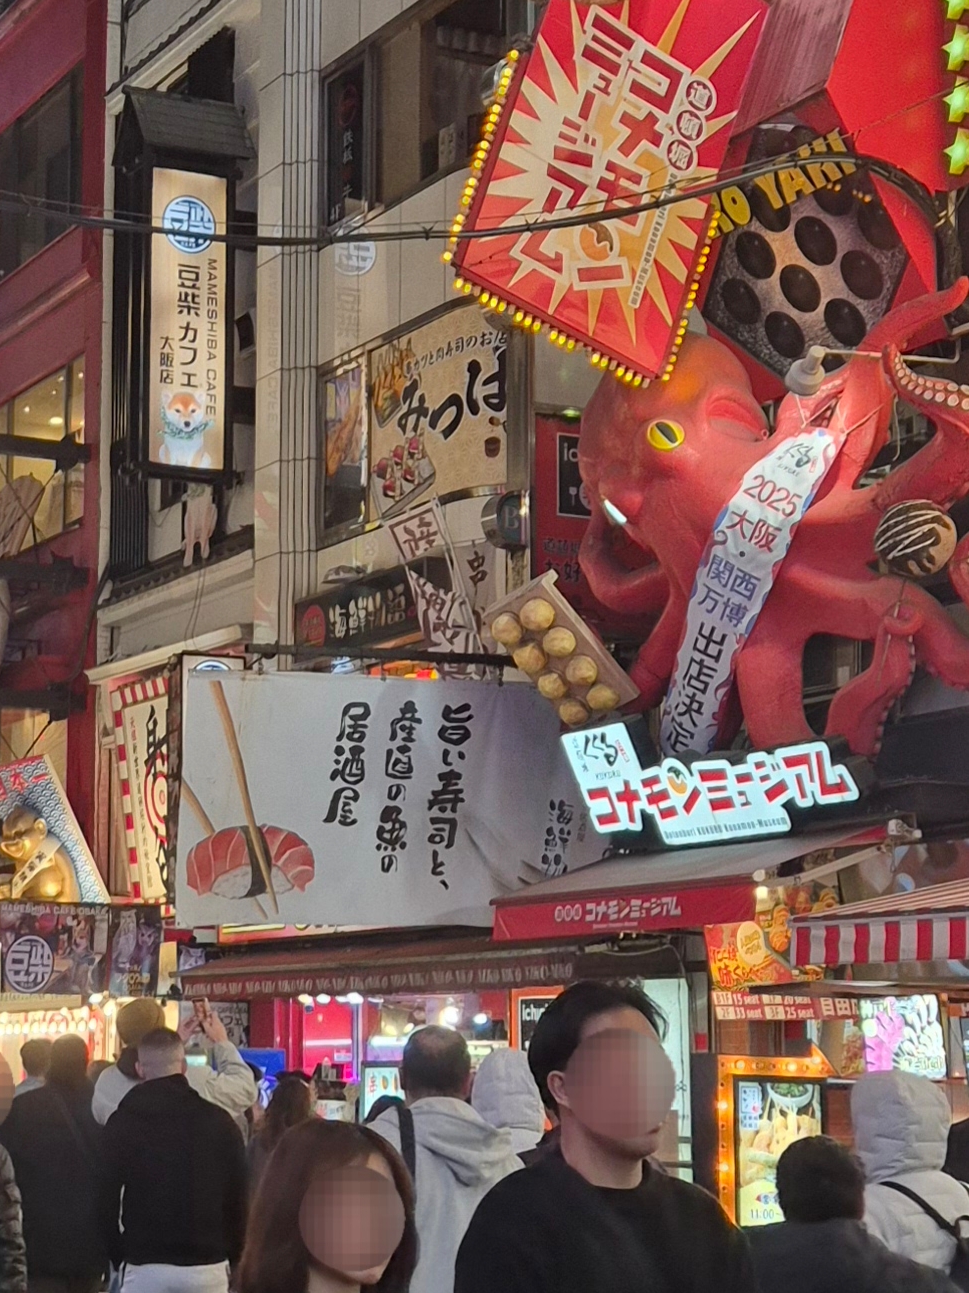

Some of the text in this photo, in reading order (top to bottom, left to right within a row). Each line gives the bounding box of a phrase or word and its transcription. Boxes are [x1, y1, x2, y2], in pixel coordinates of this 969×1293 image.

[177, 263, 201, 388] 豆柴カフェ
[205, 258, 219, 416] MAMESHIBA CAFE
[159, 335, 174, 385] 大阪店
[742, 475, 803, 517] 2025
[727, 510, 779, 553] 大阪
[706, 553, 762, 600] 関西
[698, 586, 751, 628] 万博
[666, 622, 727, 753] 出店決定
[323, 702, 371, 826] 居酒屋
[376, 700, 422, 874] 産直の魚の
[733, 993, 743, 1005] 15
[735, 1006, 746, 1018] 33
[746, 1008, 762, 1018] seat
[786, 1006, 796, 1018] 25
[798, 1006, 814, 1018] seat
